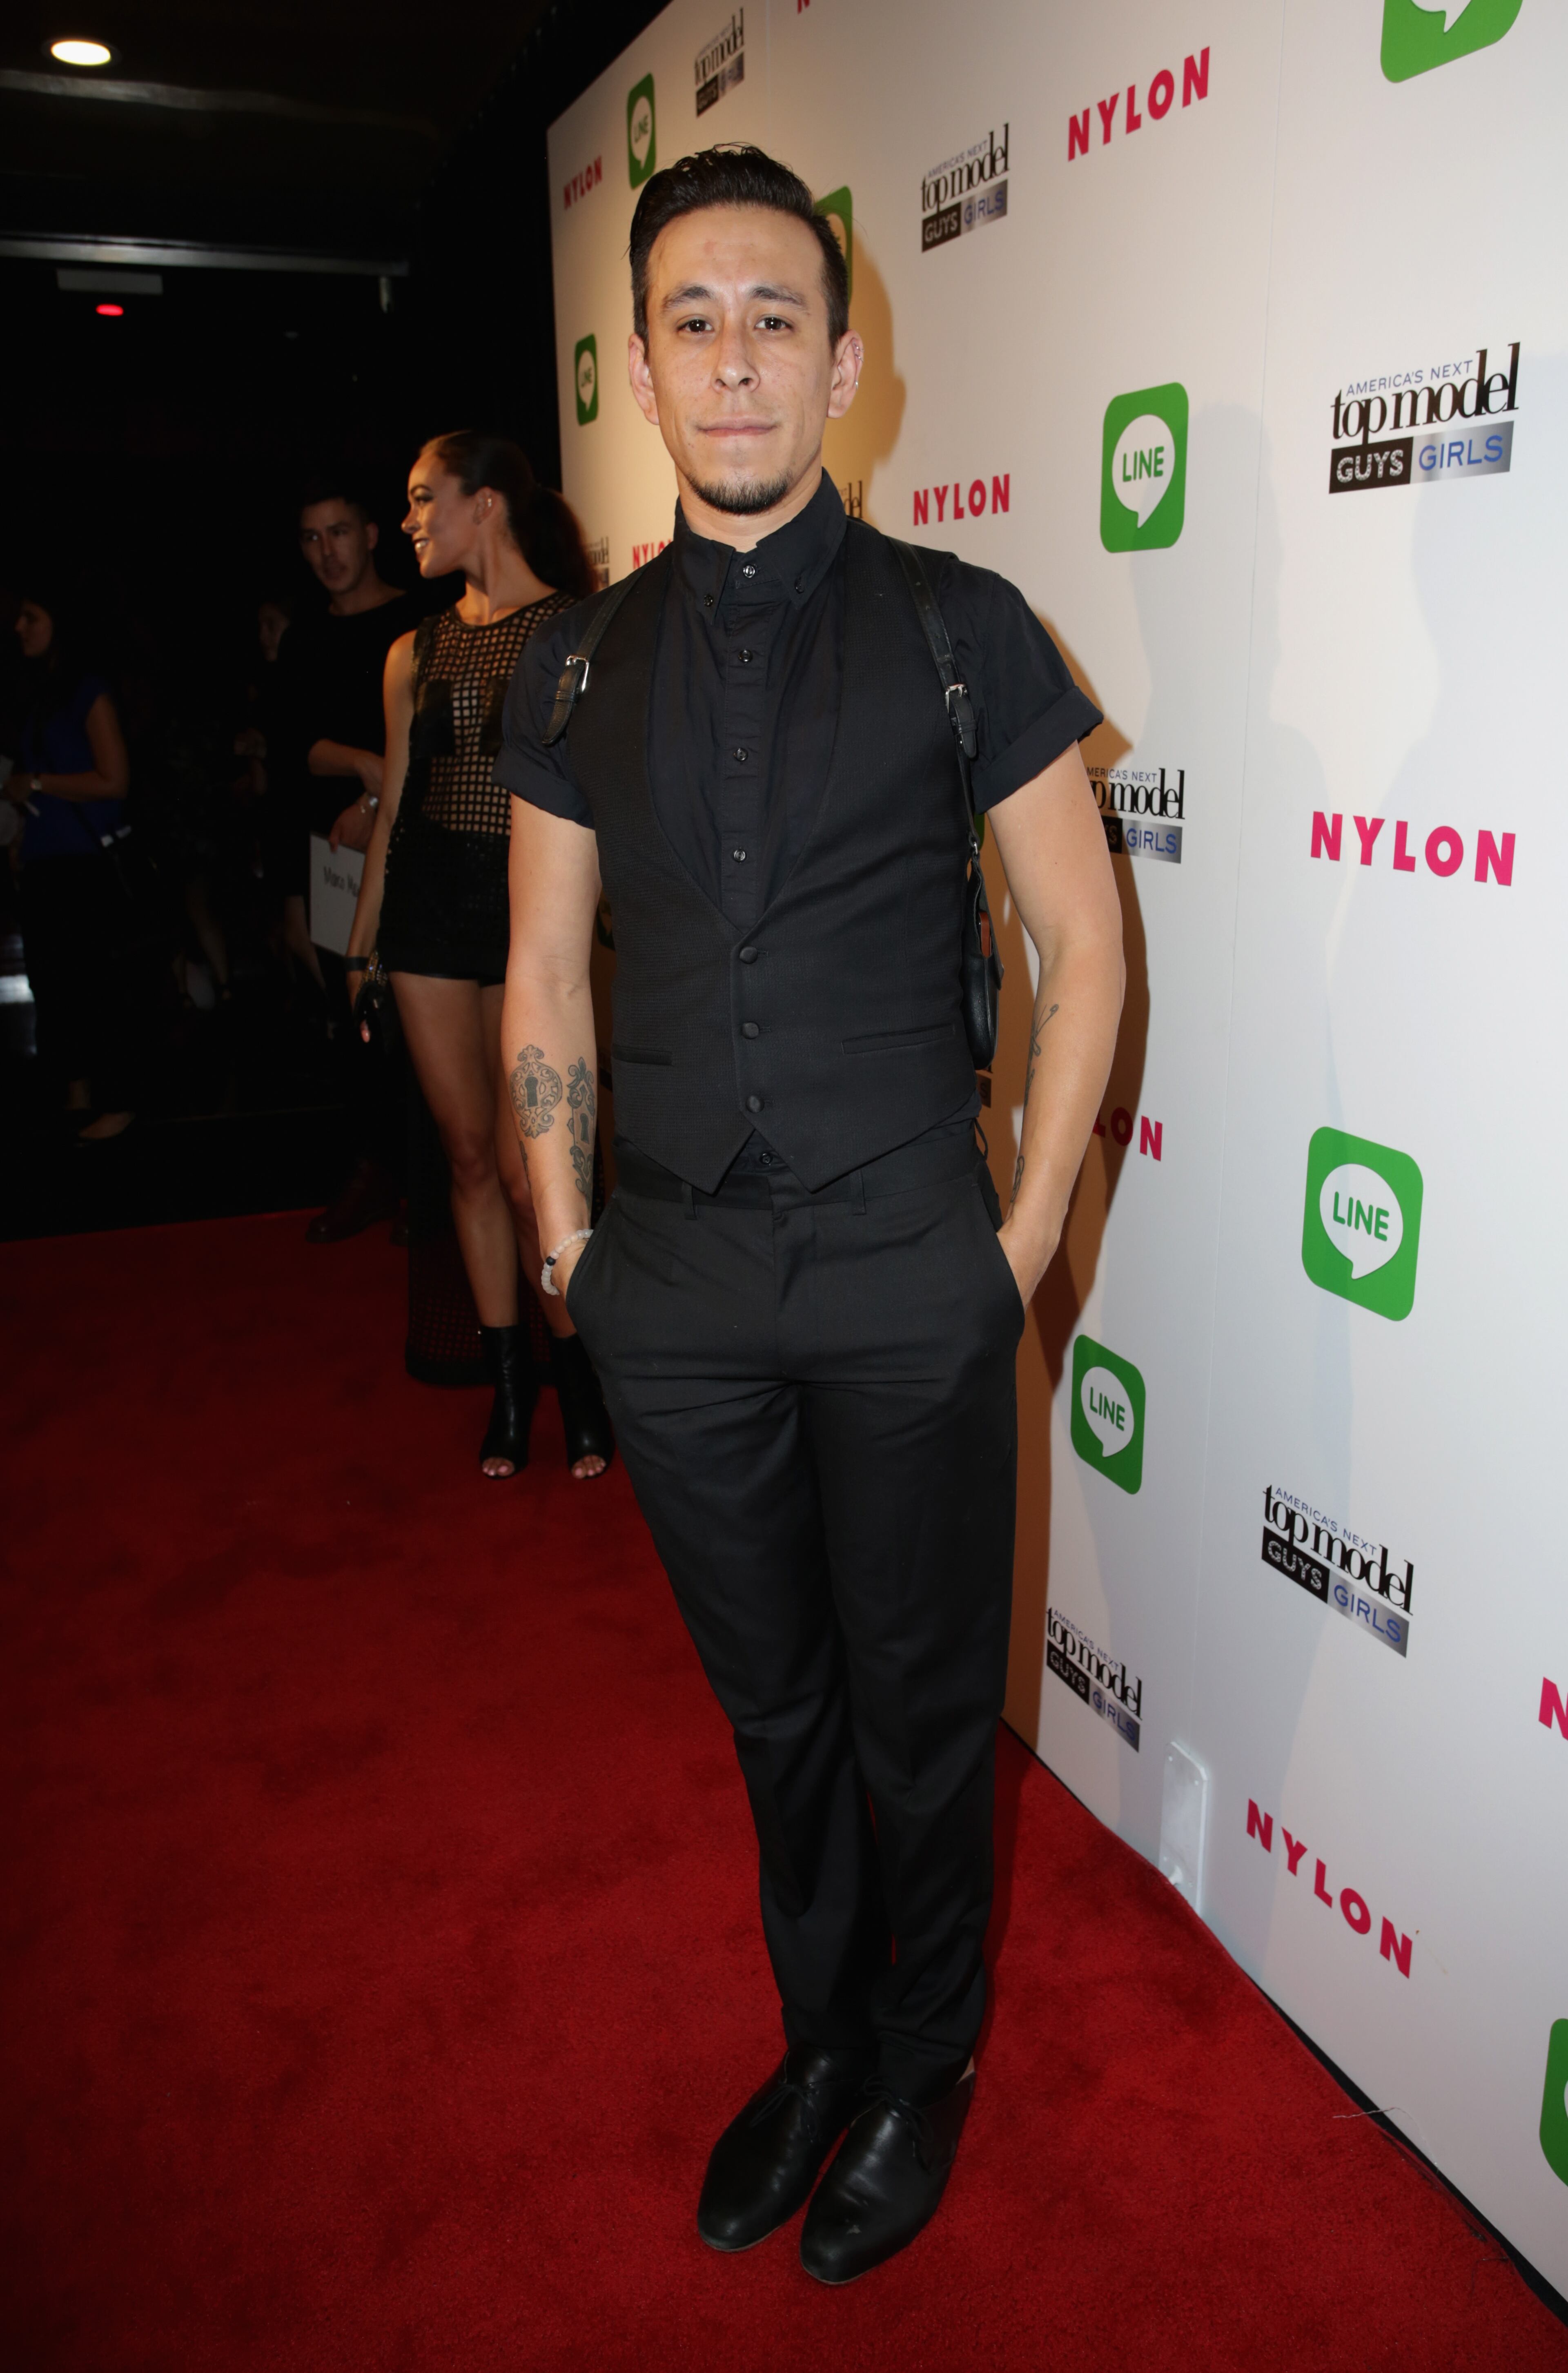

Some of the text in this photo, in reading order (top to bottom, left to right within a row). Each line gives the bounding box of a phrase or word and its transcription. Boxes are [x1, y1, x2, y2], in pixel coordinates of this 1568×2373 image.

[1069, 46, 1210, 162] NYLON
[921, 123, 1009, 213] top model
[967, 140, 988, 160] NEXT
[564, 154, 602, 210] NYLON
[924, 189, 1004, 243] GUYS GIRLS
[1331, 342, 1521, 445] top model
[1346, 360, 1473, 397] AMERICA'S NEXT
[1122, 446, 1165, 482] LINE
[1336, 434, 1503, 483] GUYS GIRLS
[843, 480, 862, 518] del
[913, 474, 1010, 526] NYLON
[1087, 766, 1157, 783] MERICA'S NEXT
[1108, 767, 1185, 820] model
[1126, 828, 1177, 854] GIRLS
[1311, 811, 1516, 887] NYLON
[1093, 1107, 1163, 1161] LON
[1333, 1191, 1390, 1242] LINE
[1089, 1386, 1125, 1431] LINE
[1275, 1487, 1377, 1555] AMERICA'S NEXT
[1263, 1484, 1414, 1616] top model
[1267, 1540, 1401, 1643] GUYS GIRLS
[1046, 1607, 1143, 1721] top model
[1054, 1610, 1119, 1671] AMERICA'S NEXT
[1050, 1651, 1135, 1741] GUYS GIRLS
[1246, 1798, 1413, 1979] NYLON
